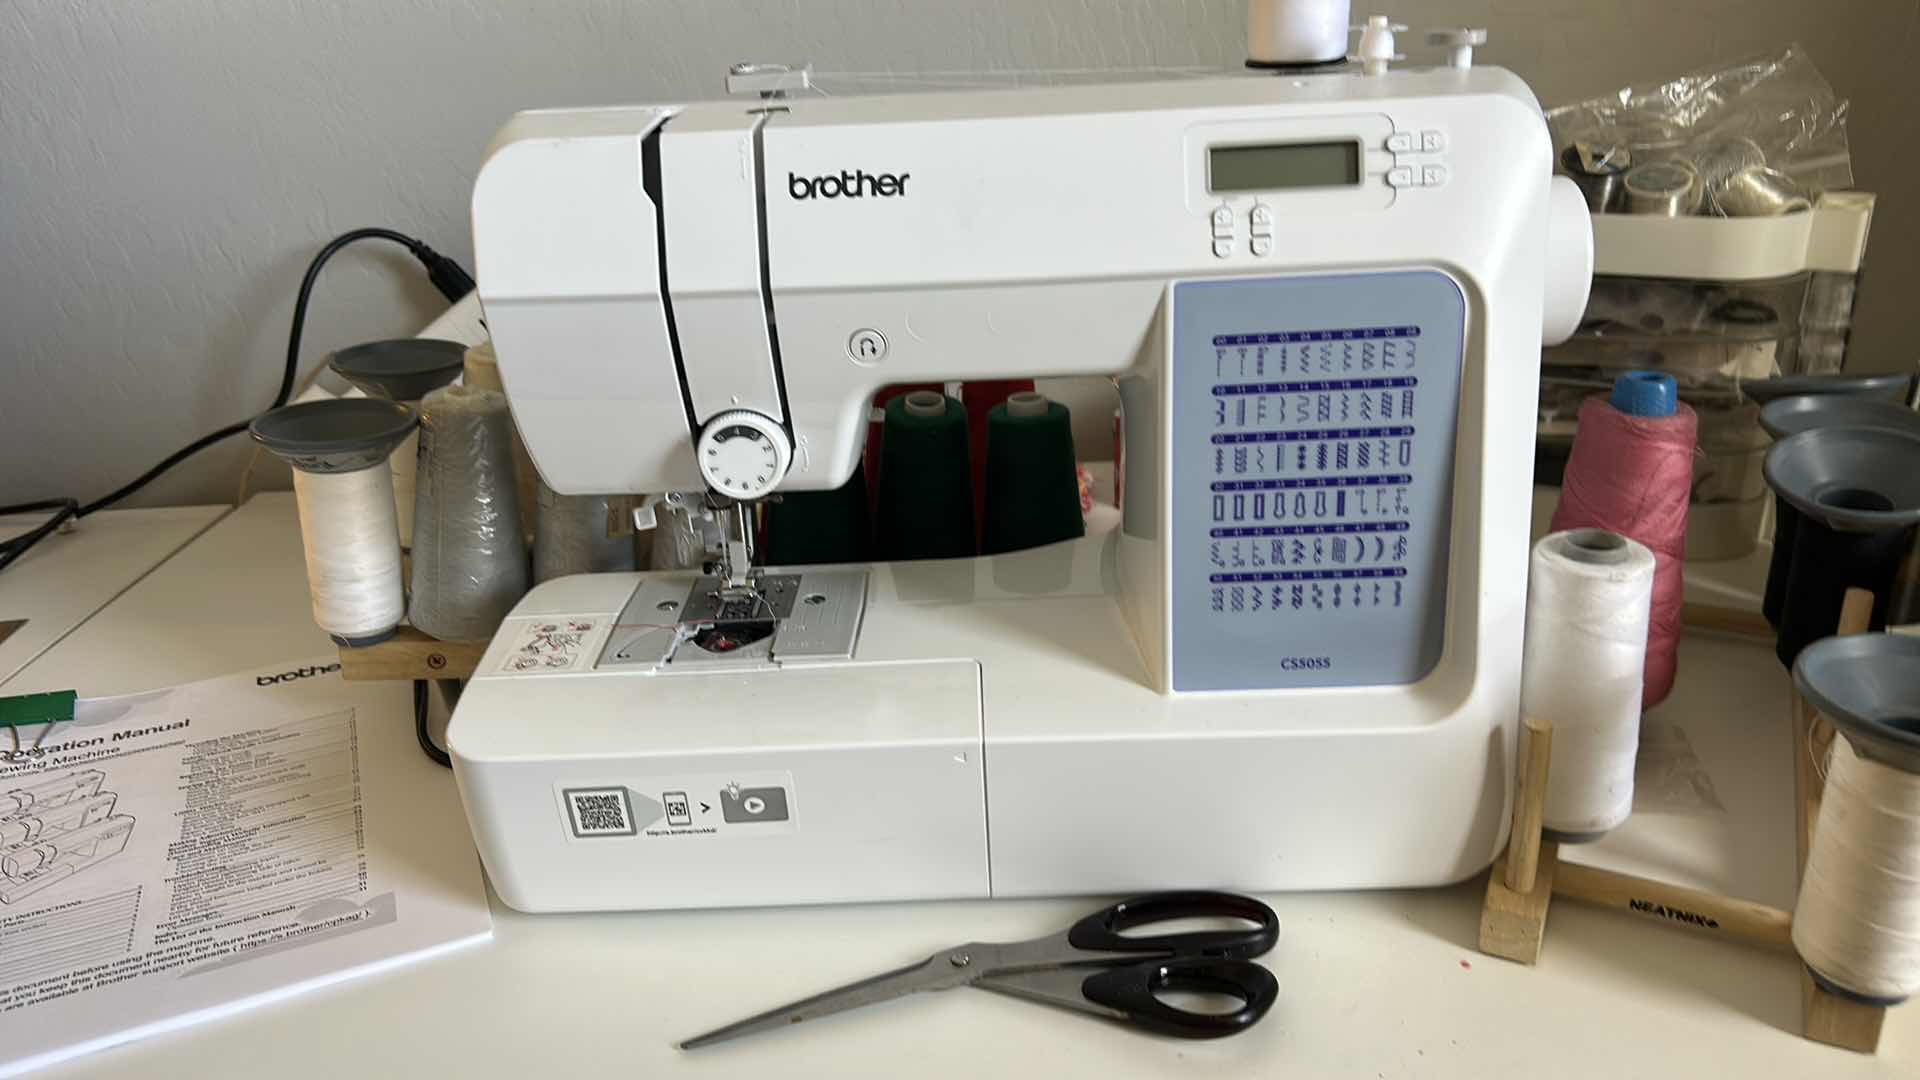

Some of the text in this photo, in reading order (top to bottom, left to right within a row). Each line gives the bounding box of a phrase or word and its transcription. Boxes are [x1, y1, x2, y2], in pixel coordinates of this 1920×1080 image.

[788, 169, 910, 200] brother
[112, 718, 190, 742] Manual
[52, 747, 120, 766] Machine
[12, 973, 70, 993] document
[72, 964, 109, 978] before
[111, 955, 142, 968] using
[145, 949, 163, 959] the
[27, 987, 79, 1006] available
[82, 982, 93, 991] at
[96, 972, 137, 988] Brother
[142, 959, 184, 976] support
[187, 948, 230, 964] website
[39, 982, 68, 994] keep
[71, 976, 91, 986] this
[94, 961, 151, 979] document
[153, 950, 192, 965] nearby
[194, 945, 210, 954] for
[213, 932, 244, 949] future
